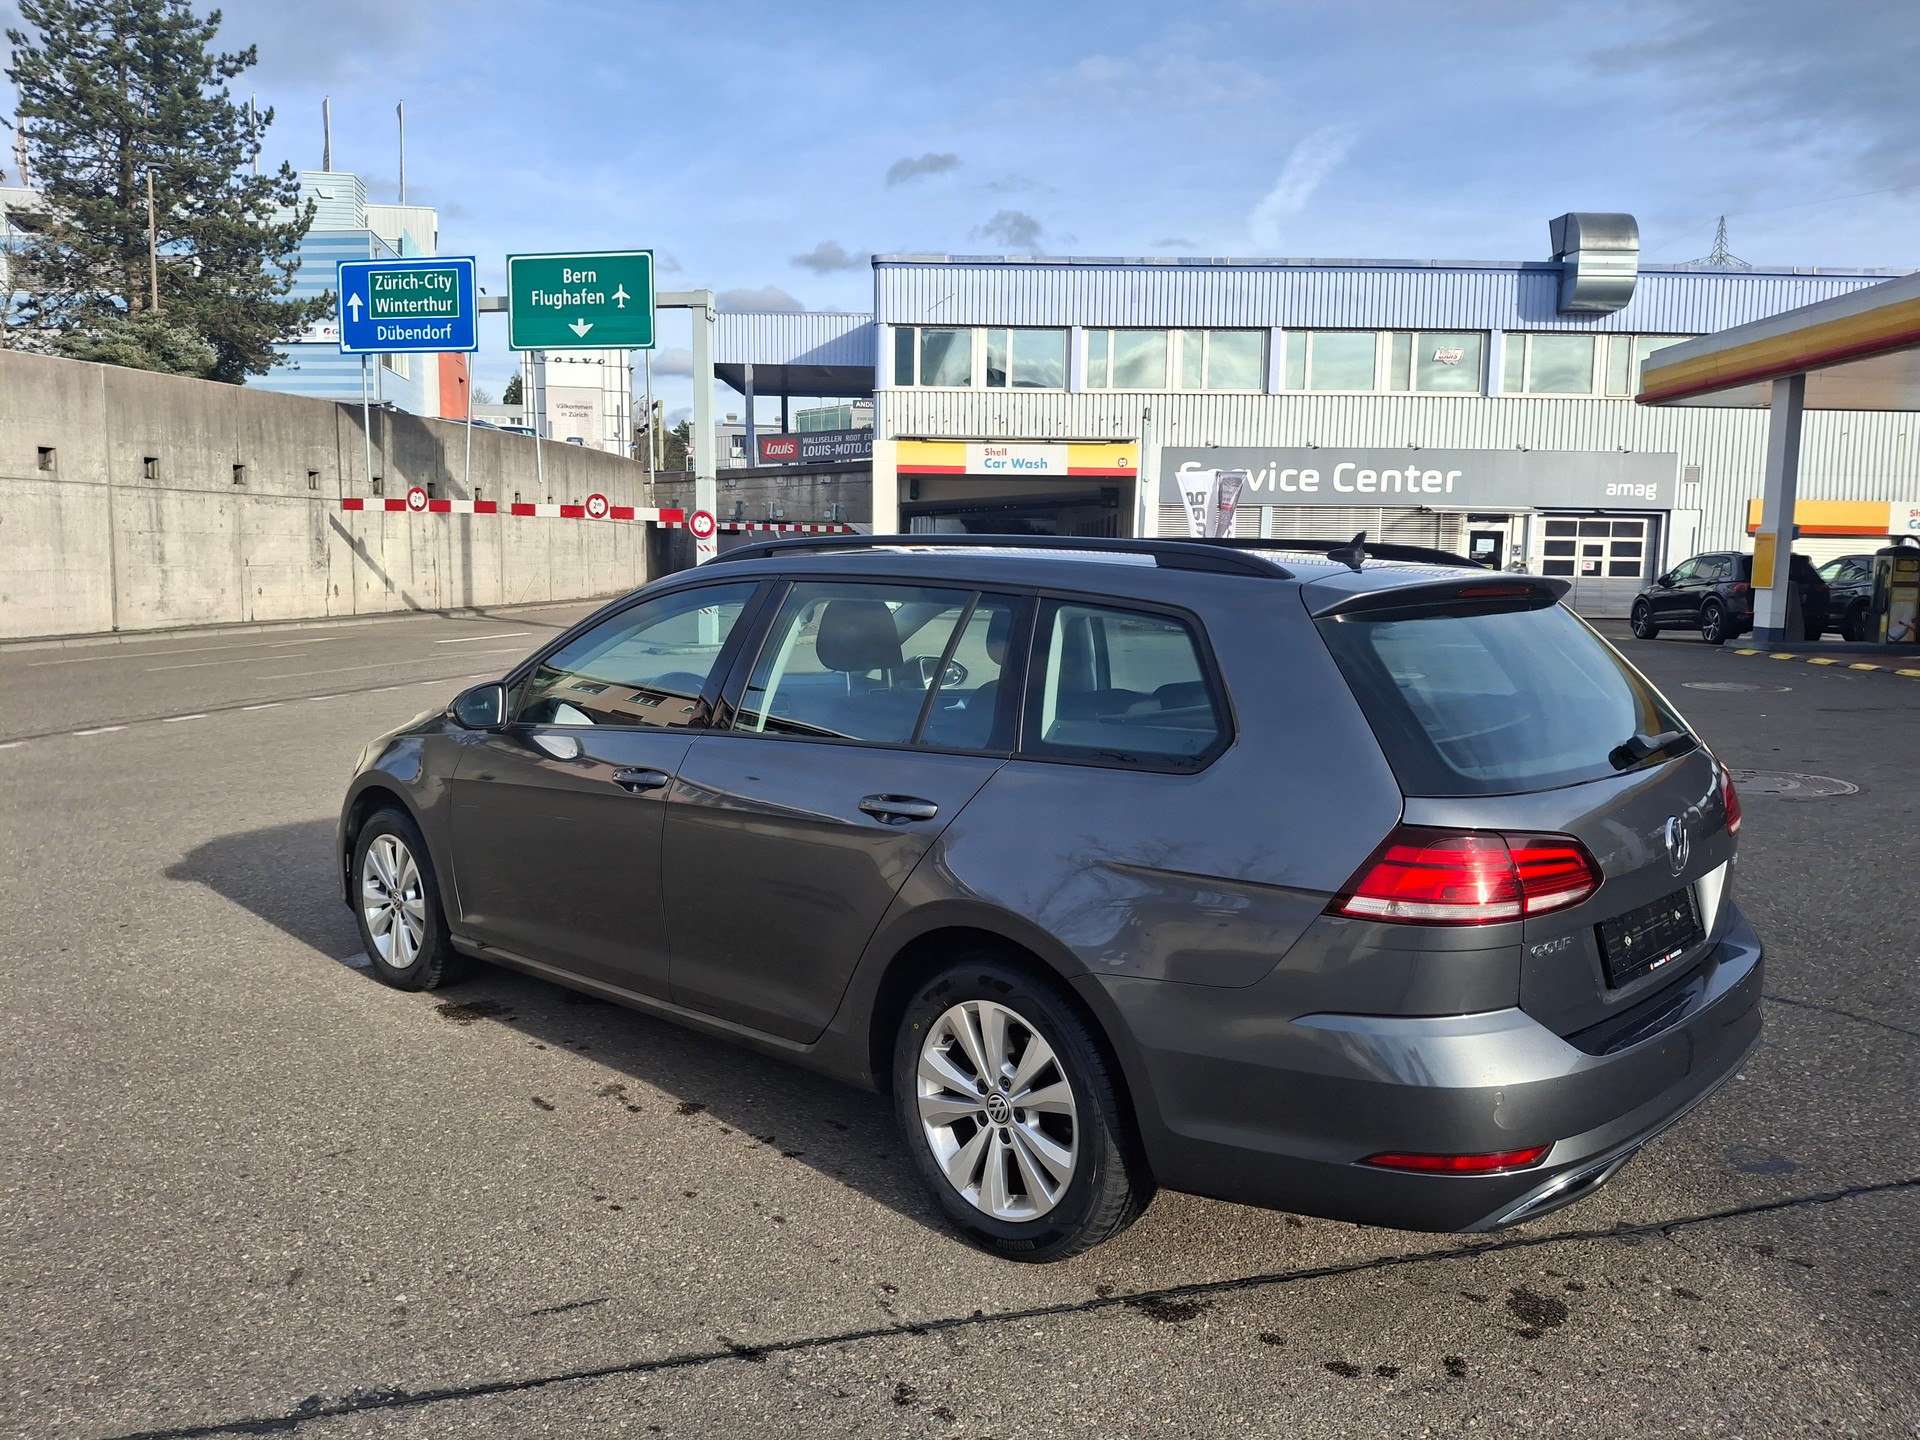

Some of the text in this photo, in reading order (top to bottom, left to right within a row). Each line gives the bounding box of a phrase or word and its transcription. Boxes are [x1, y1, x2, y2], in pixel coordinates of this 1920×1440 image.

[375, 273, 452, 293] Zürich-City
[563, 268, 596, 283] Bern
[375, 296, 453, 313] Winterthur
[531, 288, 605, 309] Flughafen
[377, 323, 452, 341] Dübendorf
[540, 356, 605, 365] VOLVO
[802, 435, 842, 445] WALLISELLEN
[845, 434, 861, 442] ROOT
[766, 442, 795, 455] Louis
[802, 442, 873, 457] LOUIS-MOTO.C
[984, 448, 1007, 456] Shell
[984, 457, 1048, 469] Car Wash
[1180, 461, 1463, 493] vice Center
[1606, 482, 1657, 500] amag
[1531, 936, 1571, 958] GOLF
